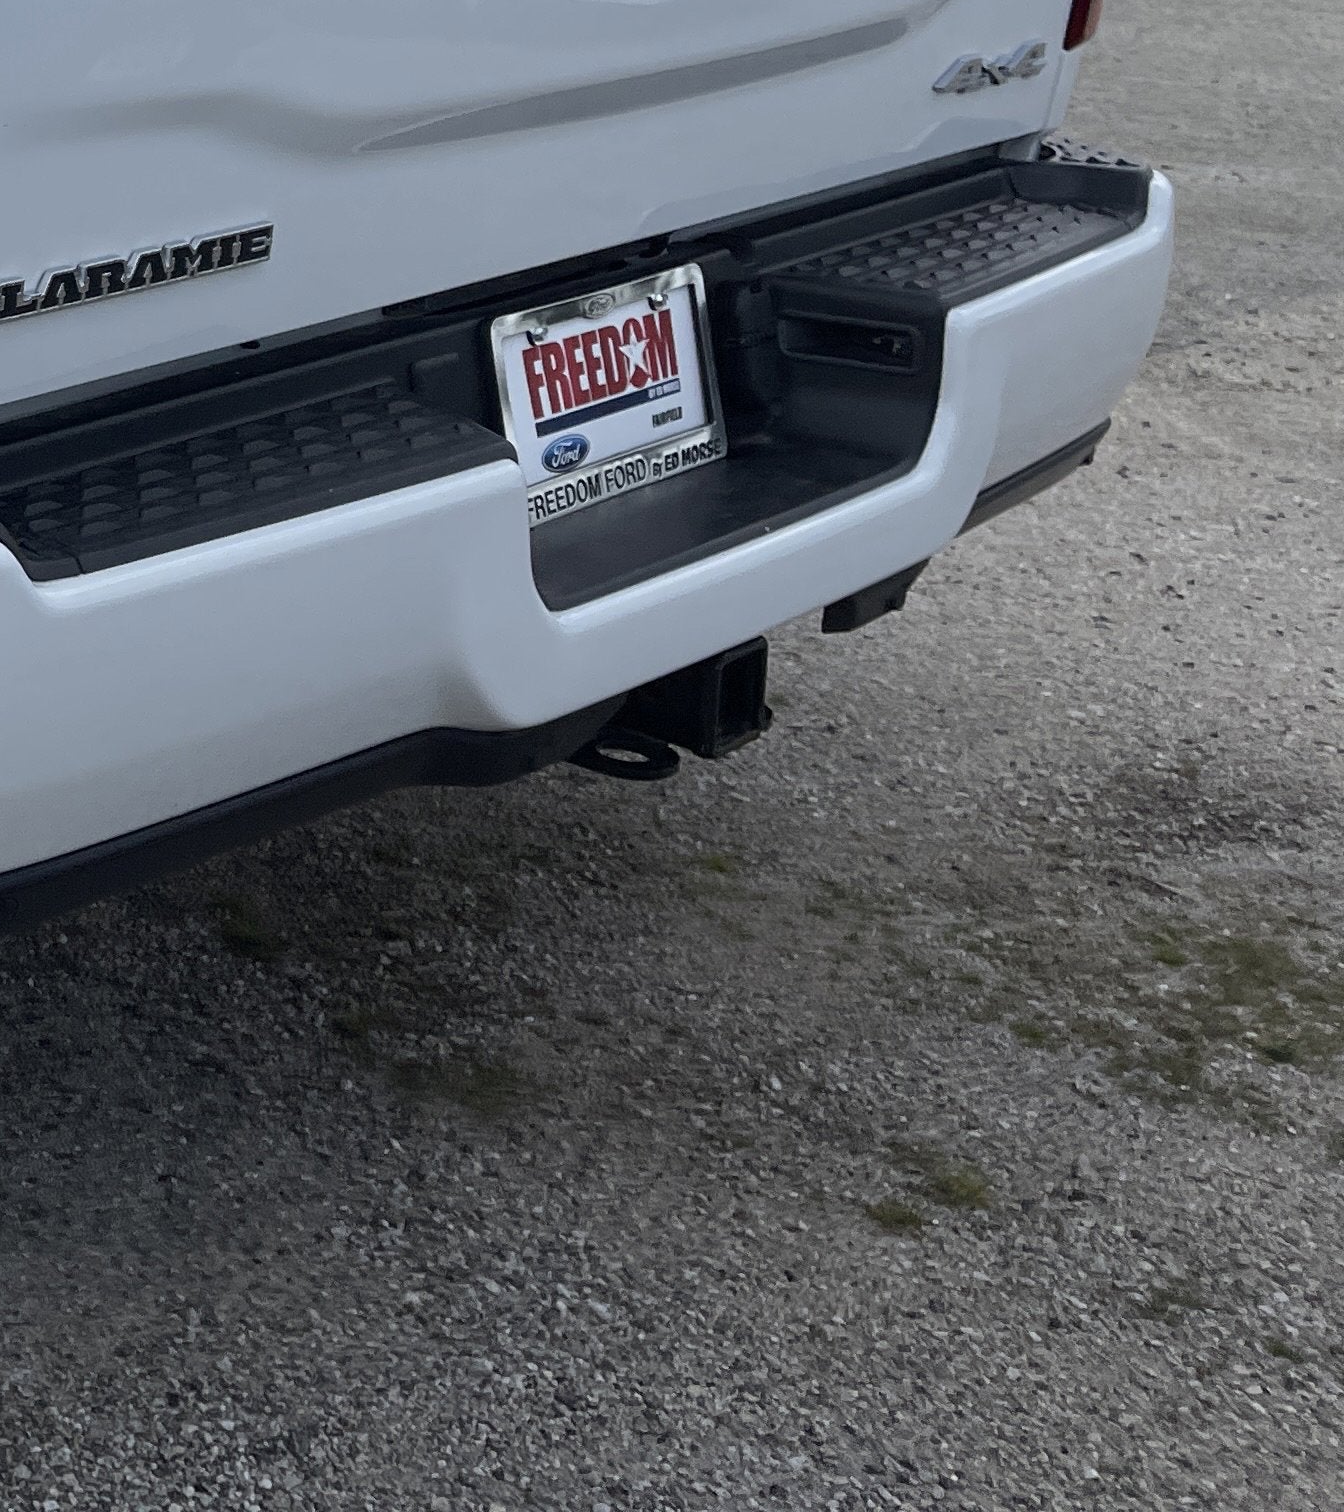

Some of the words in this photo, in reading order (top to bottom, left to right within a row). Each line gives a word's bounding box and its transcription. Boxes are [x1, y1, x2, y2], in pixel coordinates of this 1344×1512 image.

[522, 309, 679, 420] FREEDOM
[551, 442, 581, 468] Ford
[605, 458, 647, 493] FORD
[665, 451, 679, 471] ED
[681, 438, 721, 467] MORSE
